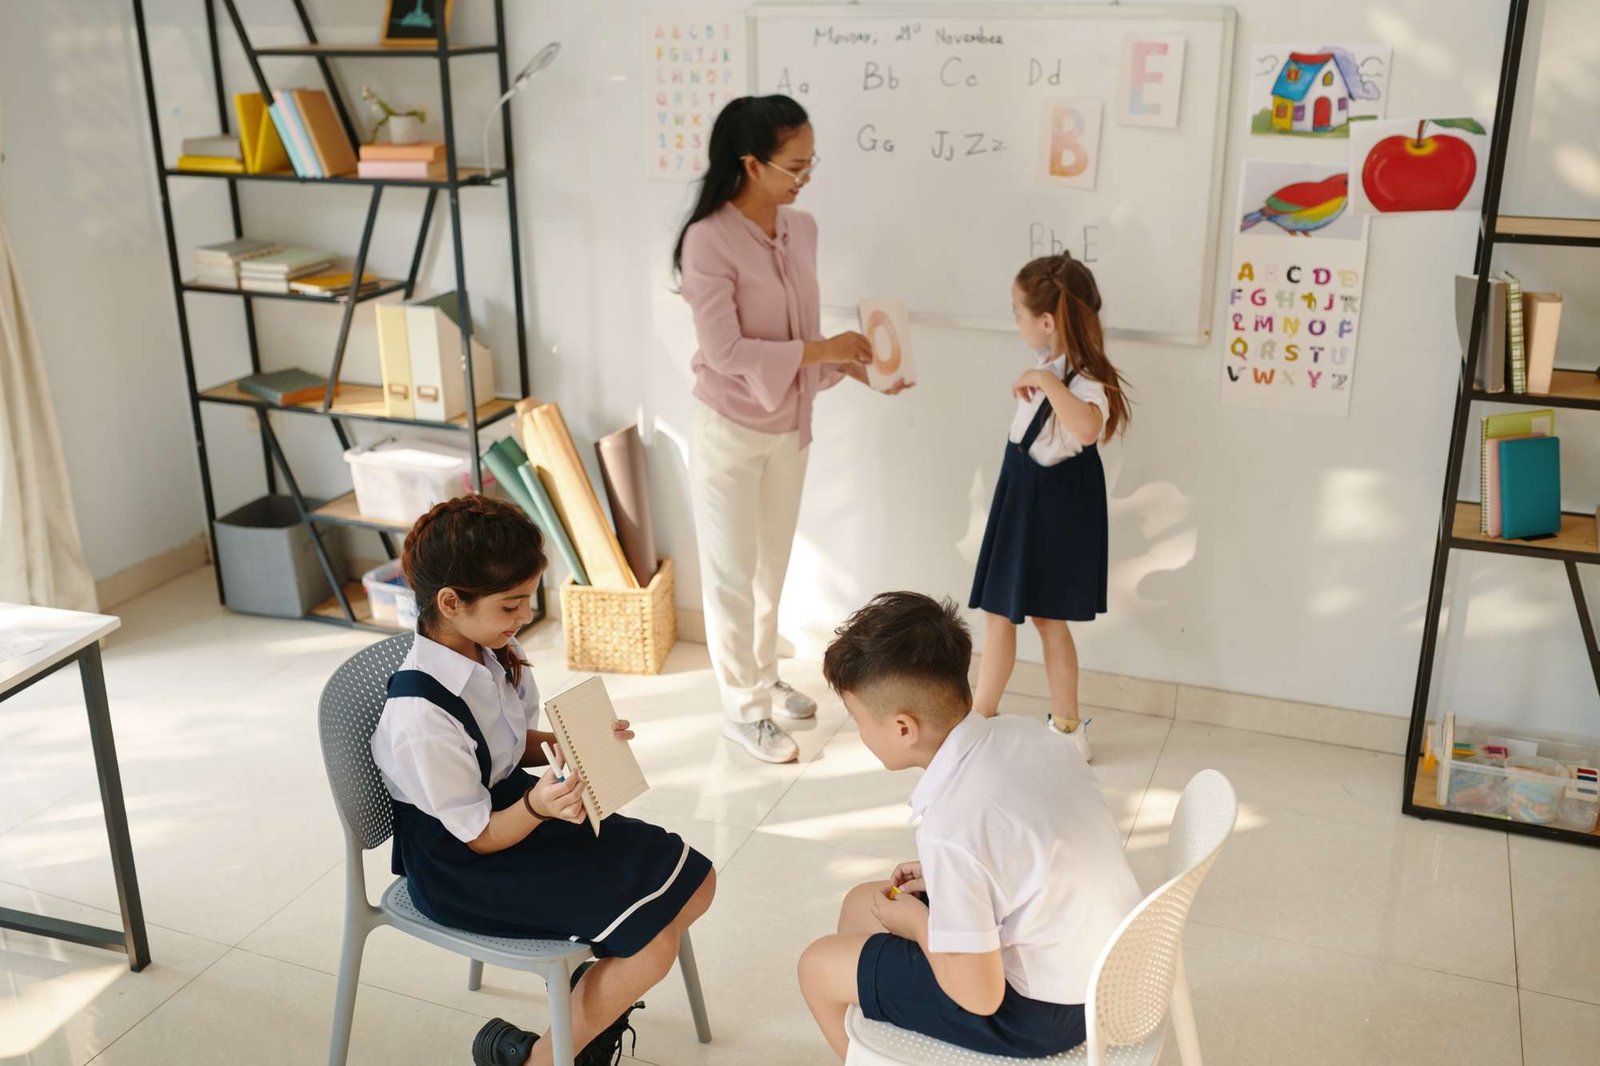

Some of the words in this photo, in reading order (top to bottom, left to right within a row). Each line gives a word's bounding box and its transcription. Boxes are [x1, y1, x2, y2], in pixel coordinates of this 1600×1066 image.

[863, 61, 900, 91] Bb
[939, 56, 979, 87] Cc
[1027, 56, 1062, 87] Dd
[1128, 41, 1169, 115] E
[675, 132, 685, 149] 2
[1049, 105, 1089, 178] B
[1237, 262, 1255, 282] A
[1286, 265, 1302, 284] C
[1312, 267, 1332, 286] D
[1230, 288, 1243, 306] F
[1250, 288, 1267, 307] G
[1275, 289, 1296, 309] H
[1323, 292, 1336, 311] J
[1254, 314, 1274, 333] M
[1282, 316, 1301, 336] N
[1308, 319, 1326, 336] O
[1337, 318, 1354, 339] P
[1230, 336, 1248, 361] Q
[1259, 339, 1277, 361] R
[1284, 344, 1300, 362] S
[1309, 346, 1325, 363] T
[1252, 367, 1276, 385] W
[1307, 370, 1323, 388] Y
